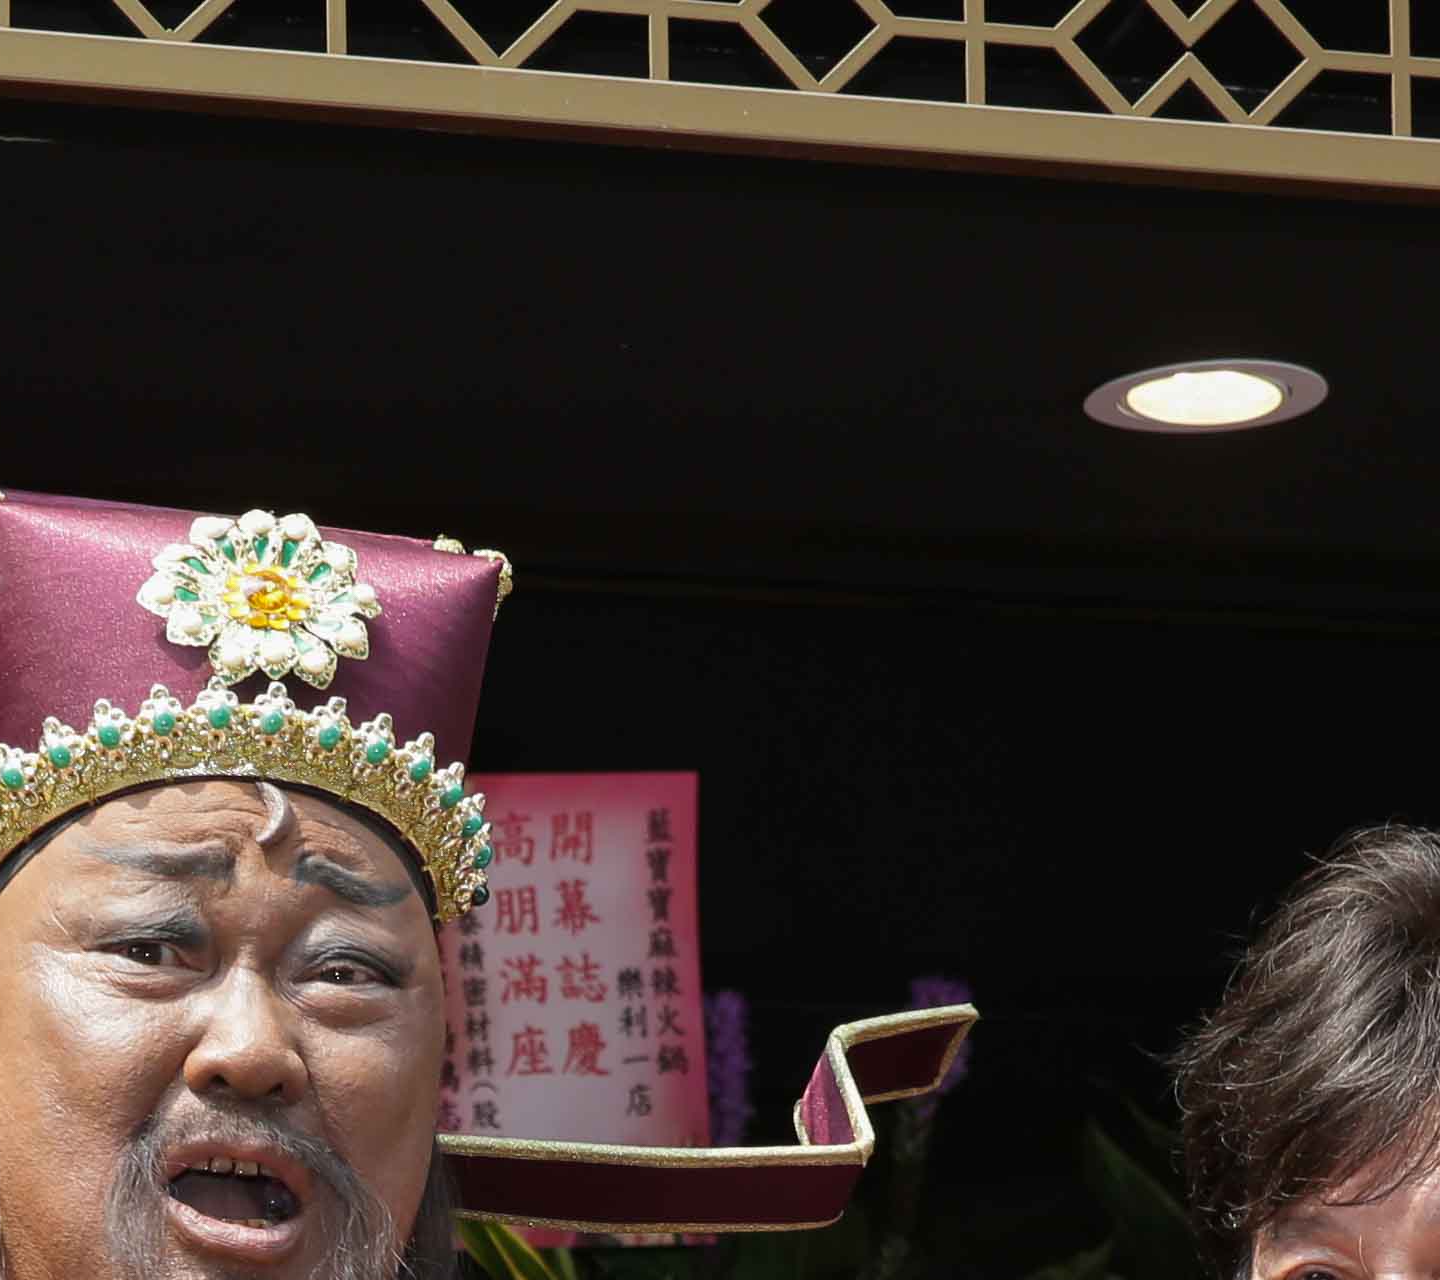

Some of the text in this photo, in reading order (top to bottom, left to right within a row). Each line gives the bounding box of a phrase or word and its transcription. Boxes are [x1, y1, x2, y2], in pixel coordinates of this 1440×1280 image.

[493, 811, 553, 1078] 高朋滿座
[548, 811, 610, 1078] 開幕誌慶
